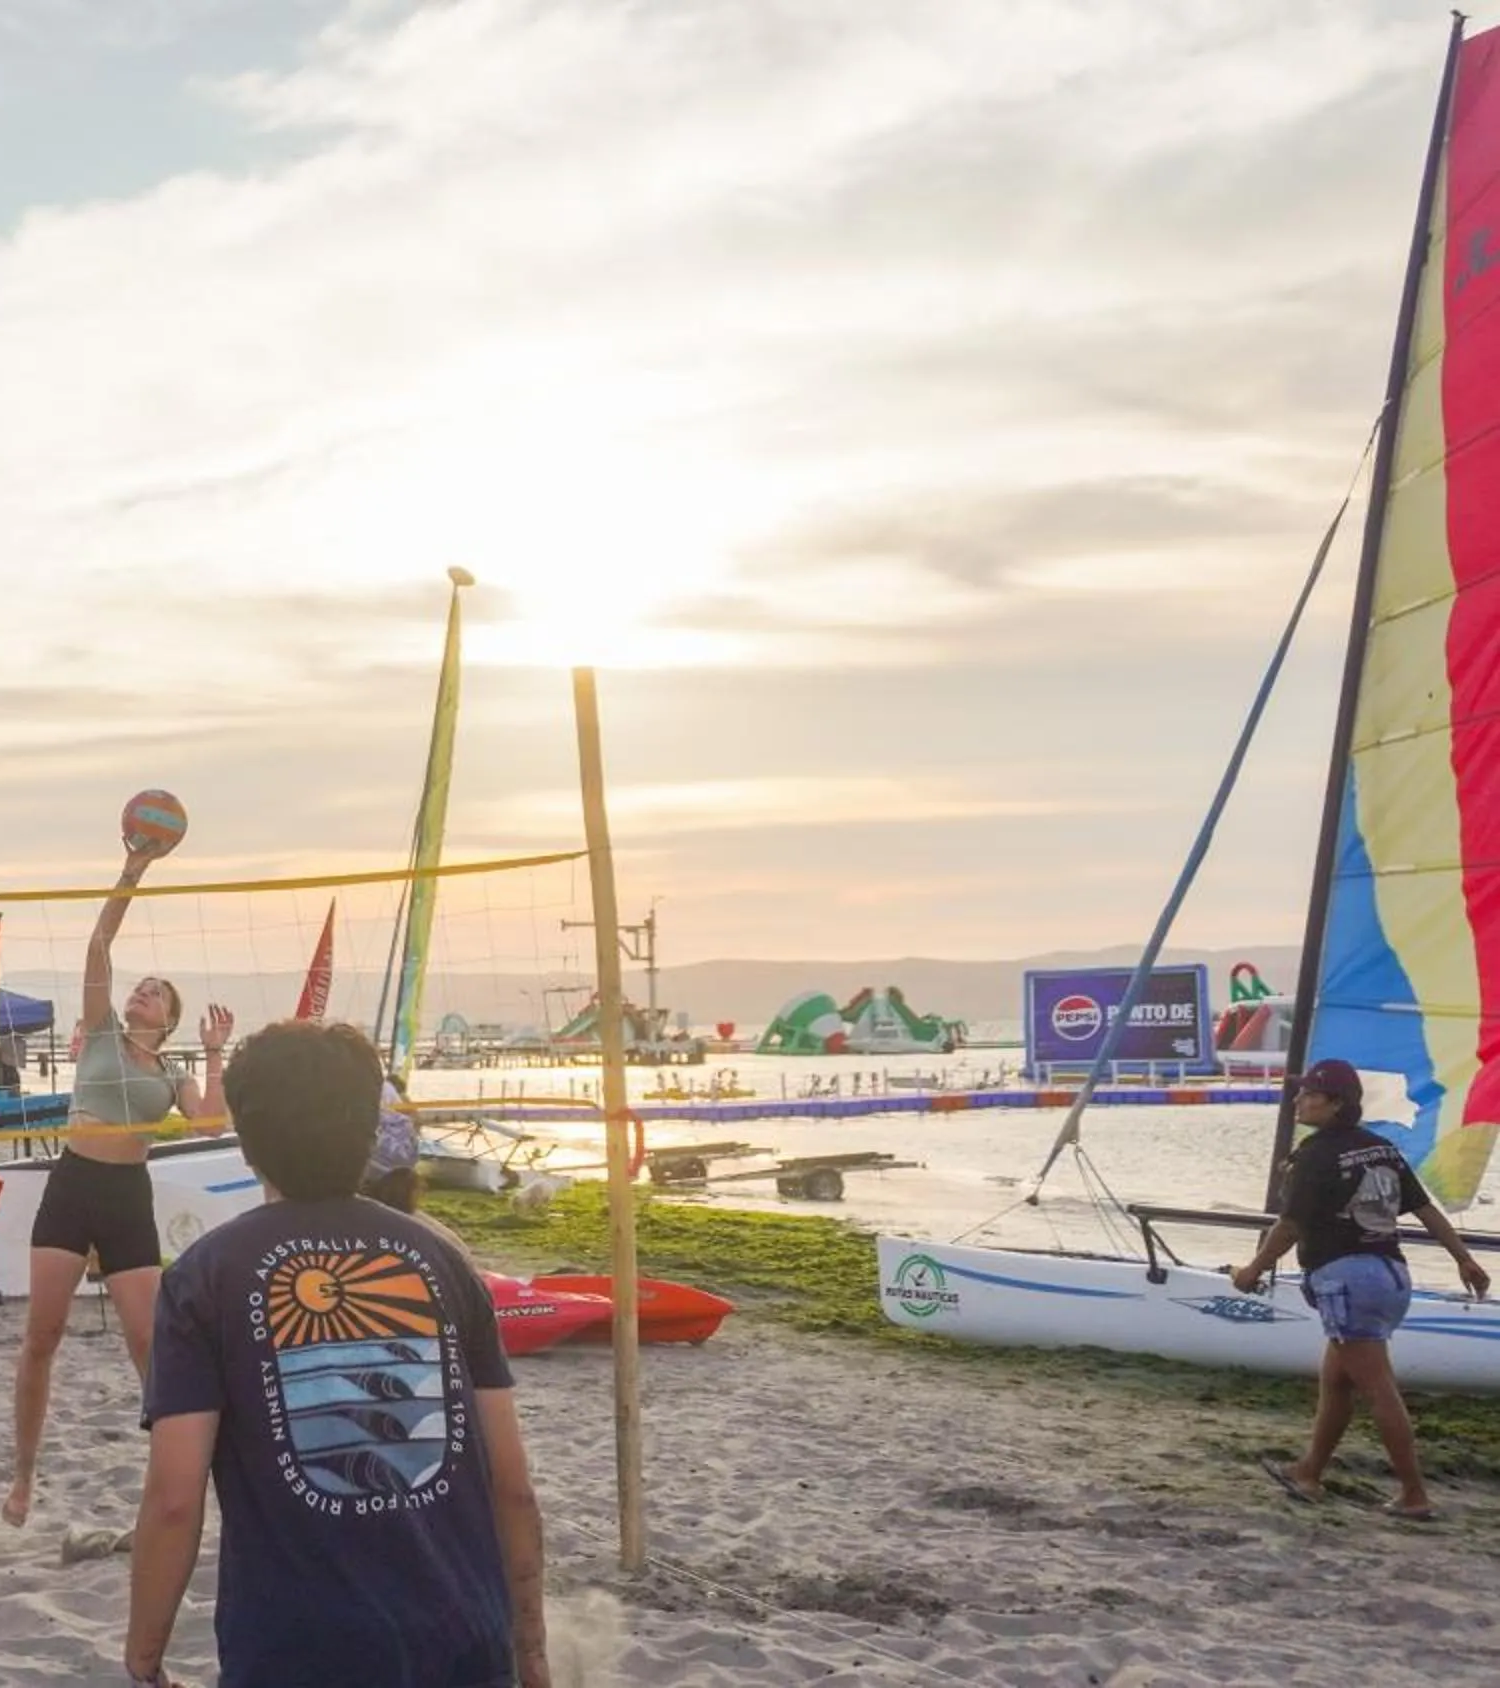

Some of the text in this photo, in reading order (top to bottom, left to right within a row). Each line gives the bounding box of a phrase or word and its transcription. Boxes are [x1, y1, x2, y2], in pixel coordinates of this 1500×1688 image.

[1107, 1003, 1195, 1020] PNTO DE
[256, 1237, 368, 1281] AUSTRALIA
[250, 1291, 268, 1341] DOO
[444, 1323, 464, 1391] SINCE
[260, 1360, 286, 1441] NINETY
[276, 1452, 343, 1515] RIDERS
[355, 1493, 399, 1515] FOR
